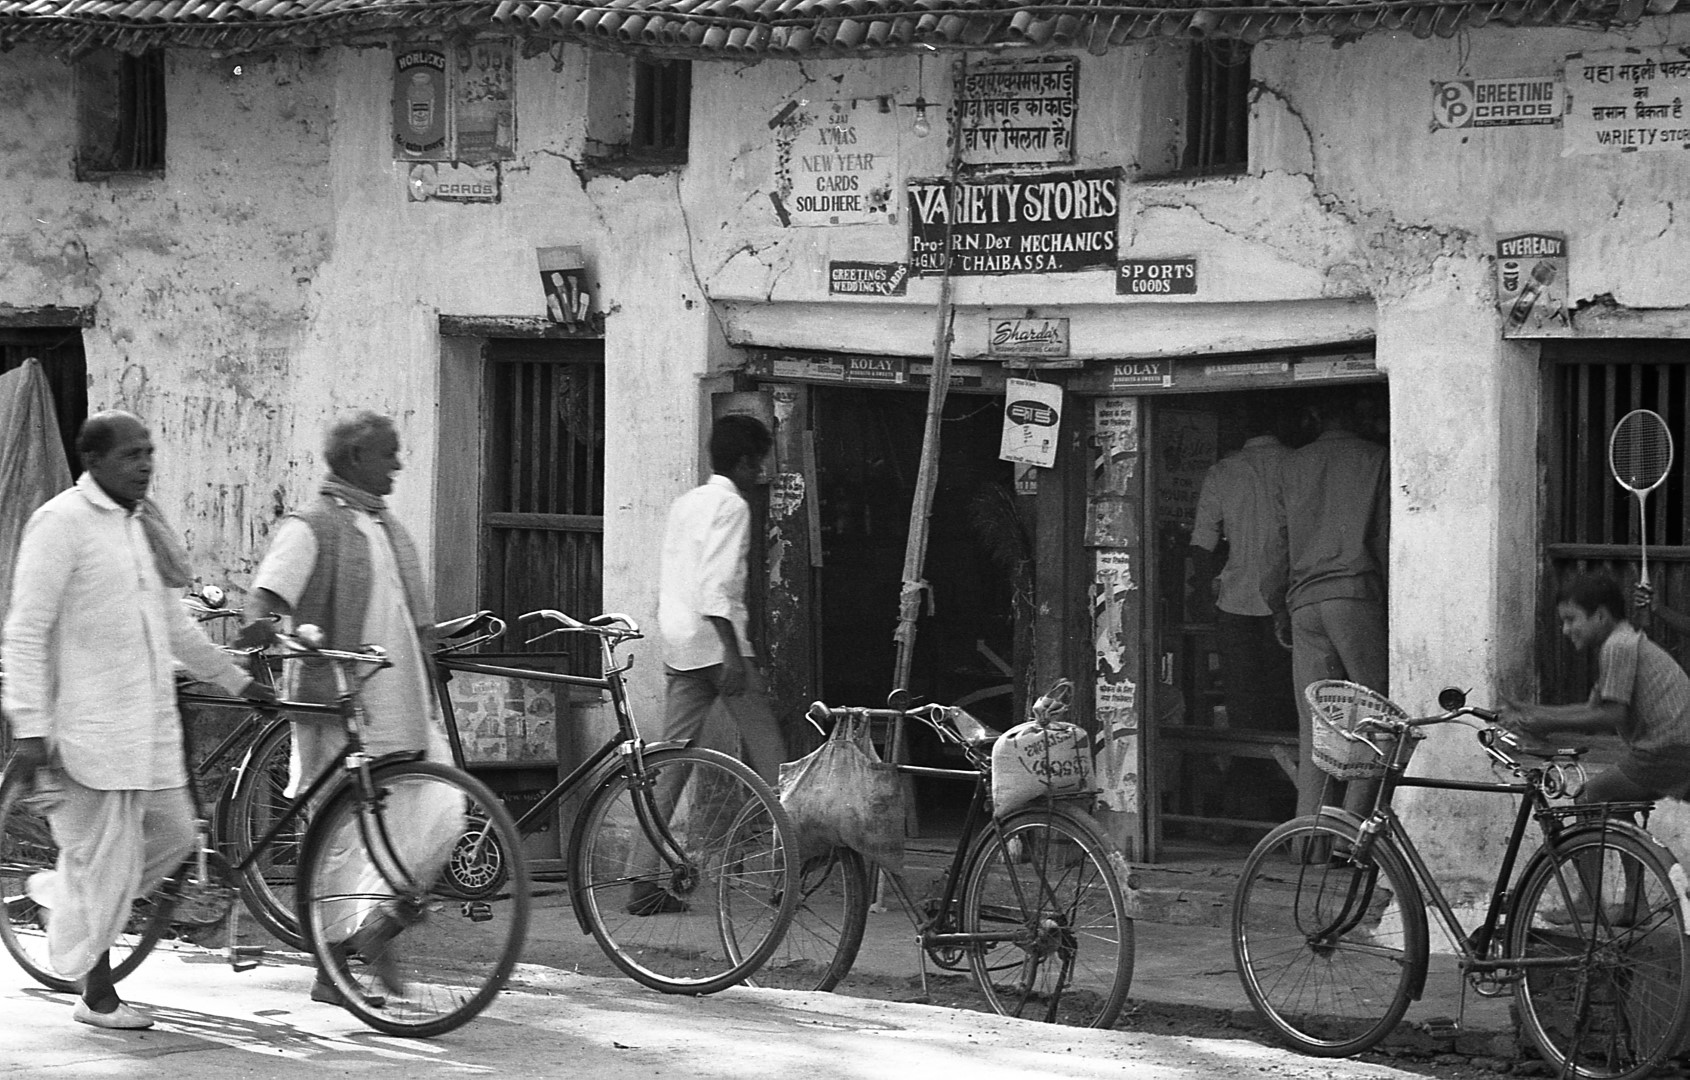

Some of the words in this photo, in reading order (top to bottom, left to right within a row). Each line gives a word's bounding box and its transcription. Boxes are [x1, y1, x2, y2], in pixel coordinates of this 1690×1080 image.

[1476, 82, 1554, 103] GREETING
[1633, 86, 1649, 99] का
[1476, 103, 1553, 117] CARDS
[1000, 119, 1050, 152] मिलता
[1596, 128, 1658, 145] VARIETY
[801, 154, 835, 172] NEW
[837, 153, 874, 171] YEAR
[439, 184, 493, 194] CARDS
[816, 175, 859, 192] CARDS
[796, 196, 830, 212] SOLD
[831, 195, 862, 212] HERE
[908, 183, 1022, 225] VARIETY
[1022, 179, 1118, 222] STORES
[1020, 231, 1115, 253] MECHANICS
[1502, 236, 1561, 256] EVEREADY
[962, 255, 1064, 272] CHAIBASSA.
[1121, 264, 1195, 279] SPORTS
[880, 264, 907, 296] CARDS
[1132, 279, 1171, 293] GOODS
[993, 320, 1063, 345] Sharda's
[850, 358, 894, 370] KOLAY
[1114, 363, 1160, 376] KOLAY
[450, 845, 498, 887] HERCULES
